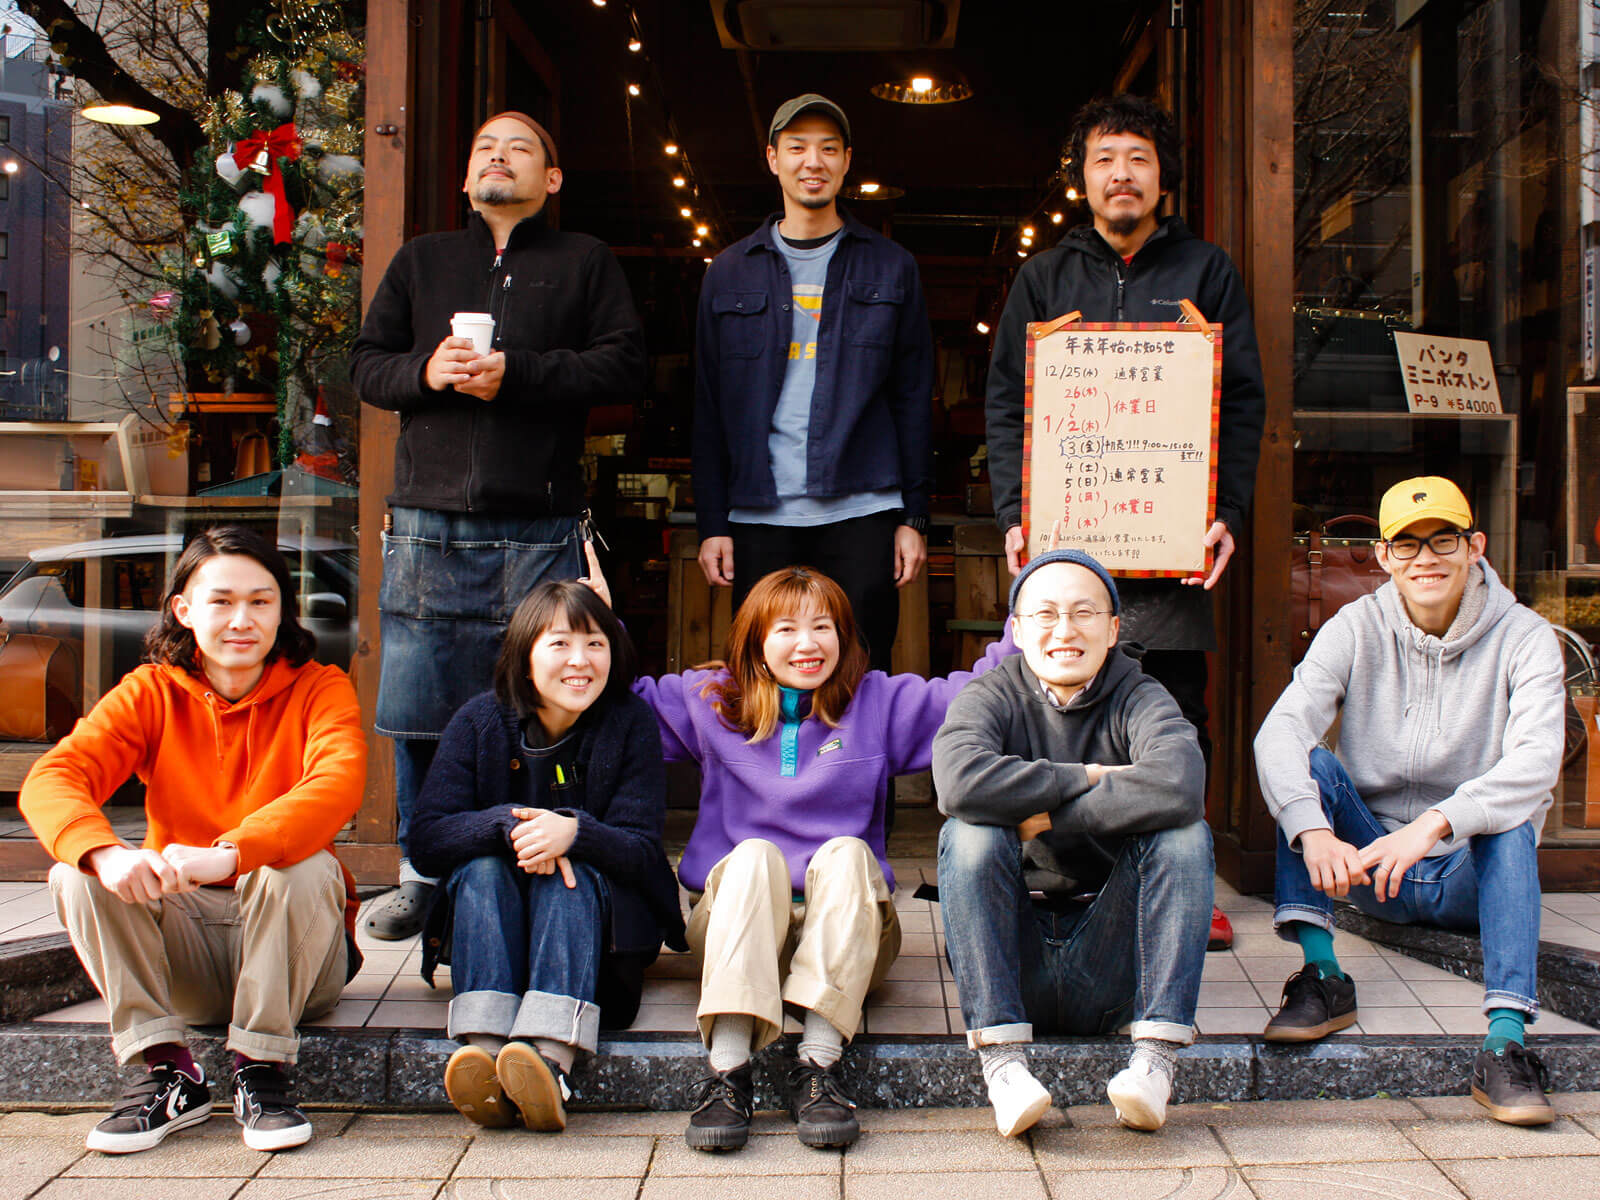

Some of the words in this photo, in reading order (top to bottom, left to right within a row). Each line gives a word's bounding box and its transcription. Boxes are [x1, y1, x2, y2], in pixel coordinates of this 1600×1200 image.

[1065, 335, 1175, 355] 年末年始のお知らせ
[1114, 365, 1164, 382] 通常営業
[1407, 365, 1490, 390] ミニボストン
[1113, 397, 1156, 414] 休業日
[1414, 394, 1438, 408] P-9
[1447, 398, 1497, 413] ¥54000
[1110, 467, 1165, 484] 通常営業
[1113, 498, 1154, 514] 休業日
